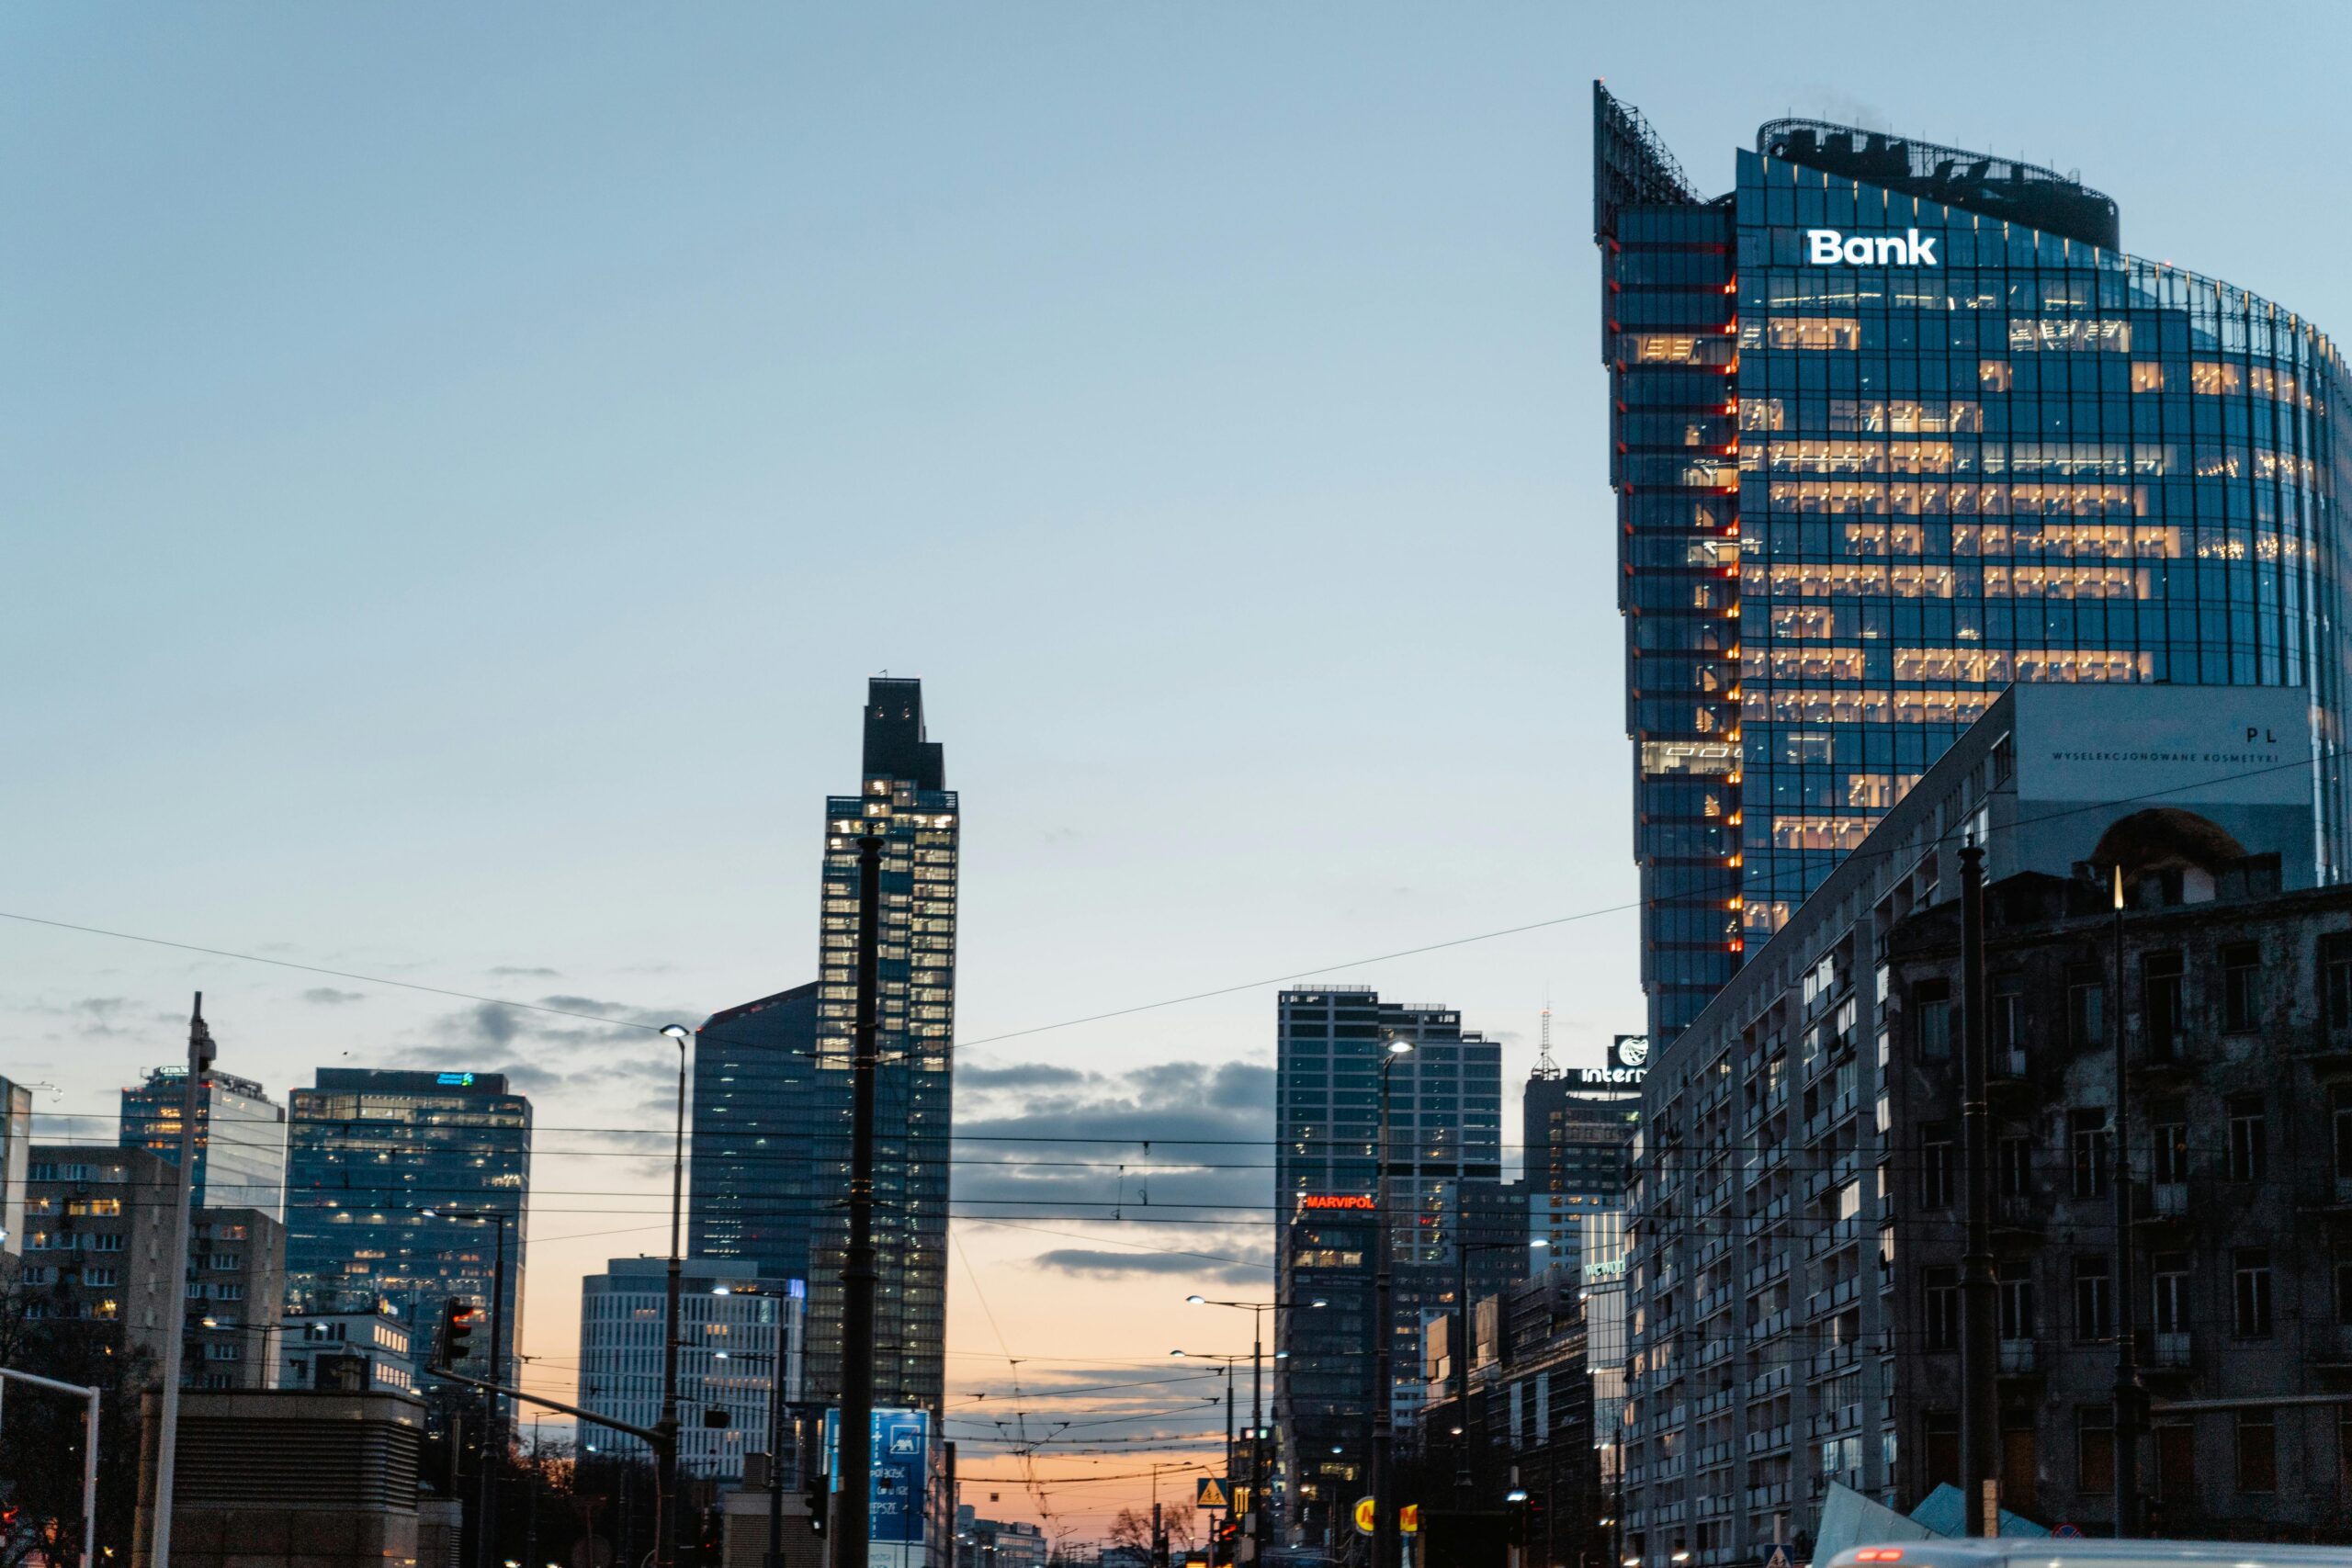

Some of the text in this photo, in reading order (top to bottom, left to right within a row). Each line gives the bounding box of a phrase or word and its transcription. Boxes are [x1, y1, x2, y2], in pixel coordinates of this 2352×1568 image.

[1806, 228, 1938, 265] Bank
[2052, 751, 2279, 763] WYSELEKCJONOWANE KOSMETYKI
[1306, 1196, 1375, 1210] MARVIPOL
